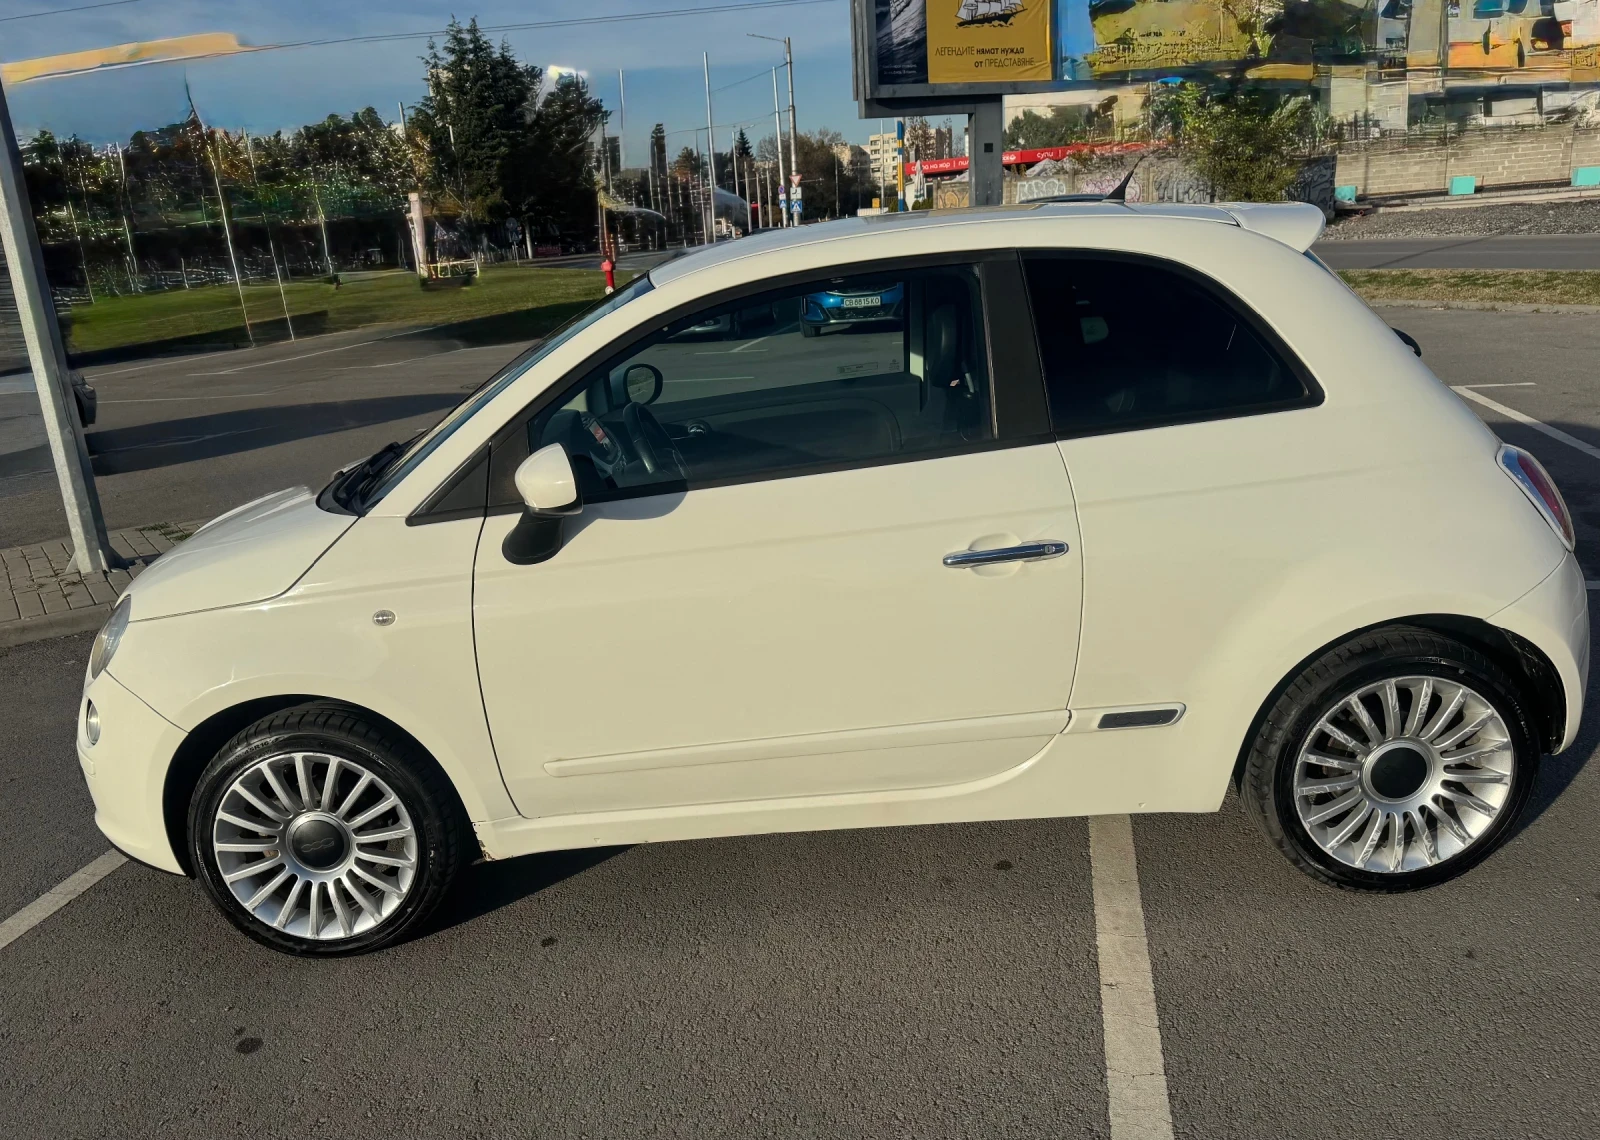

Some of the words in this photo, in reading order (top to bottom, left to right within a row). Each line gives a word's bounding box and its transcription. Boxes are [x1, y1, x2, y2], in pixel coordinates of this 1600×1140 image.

[935, 46, 975, 56] ЛЕГЕНДИТЕ
[1000, 47, 1024, 56] нужда
[974, 60, 983, 68] от
[984, 57, 1036, 68] ПРЕДСТАВЯНЕ.
[1036, 152, 1053, 160] супи
